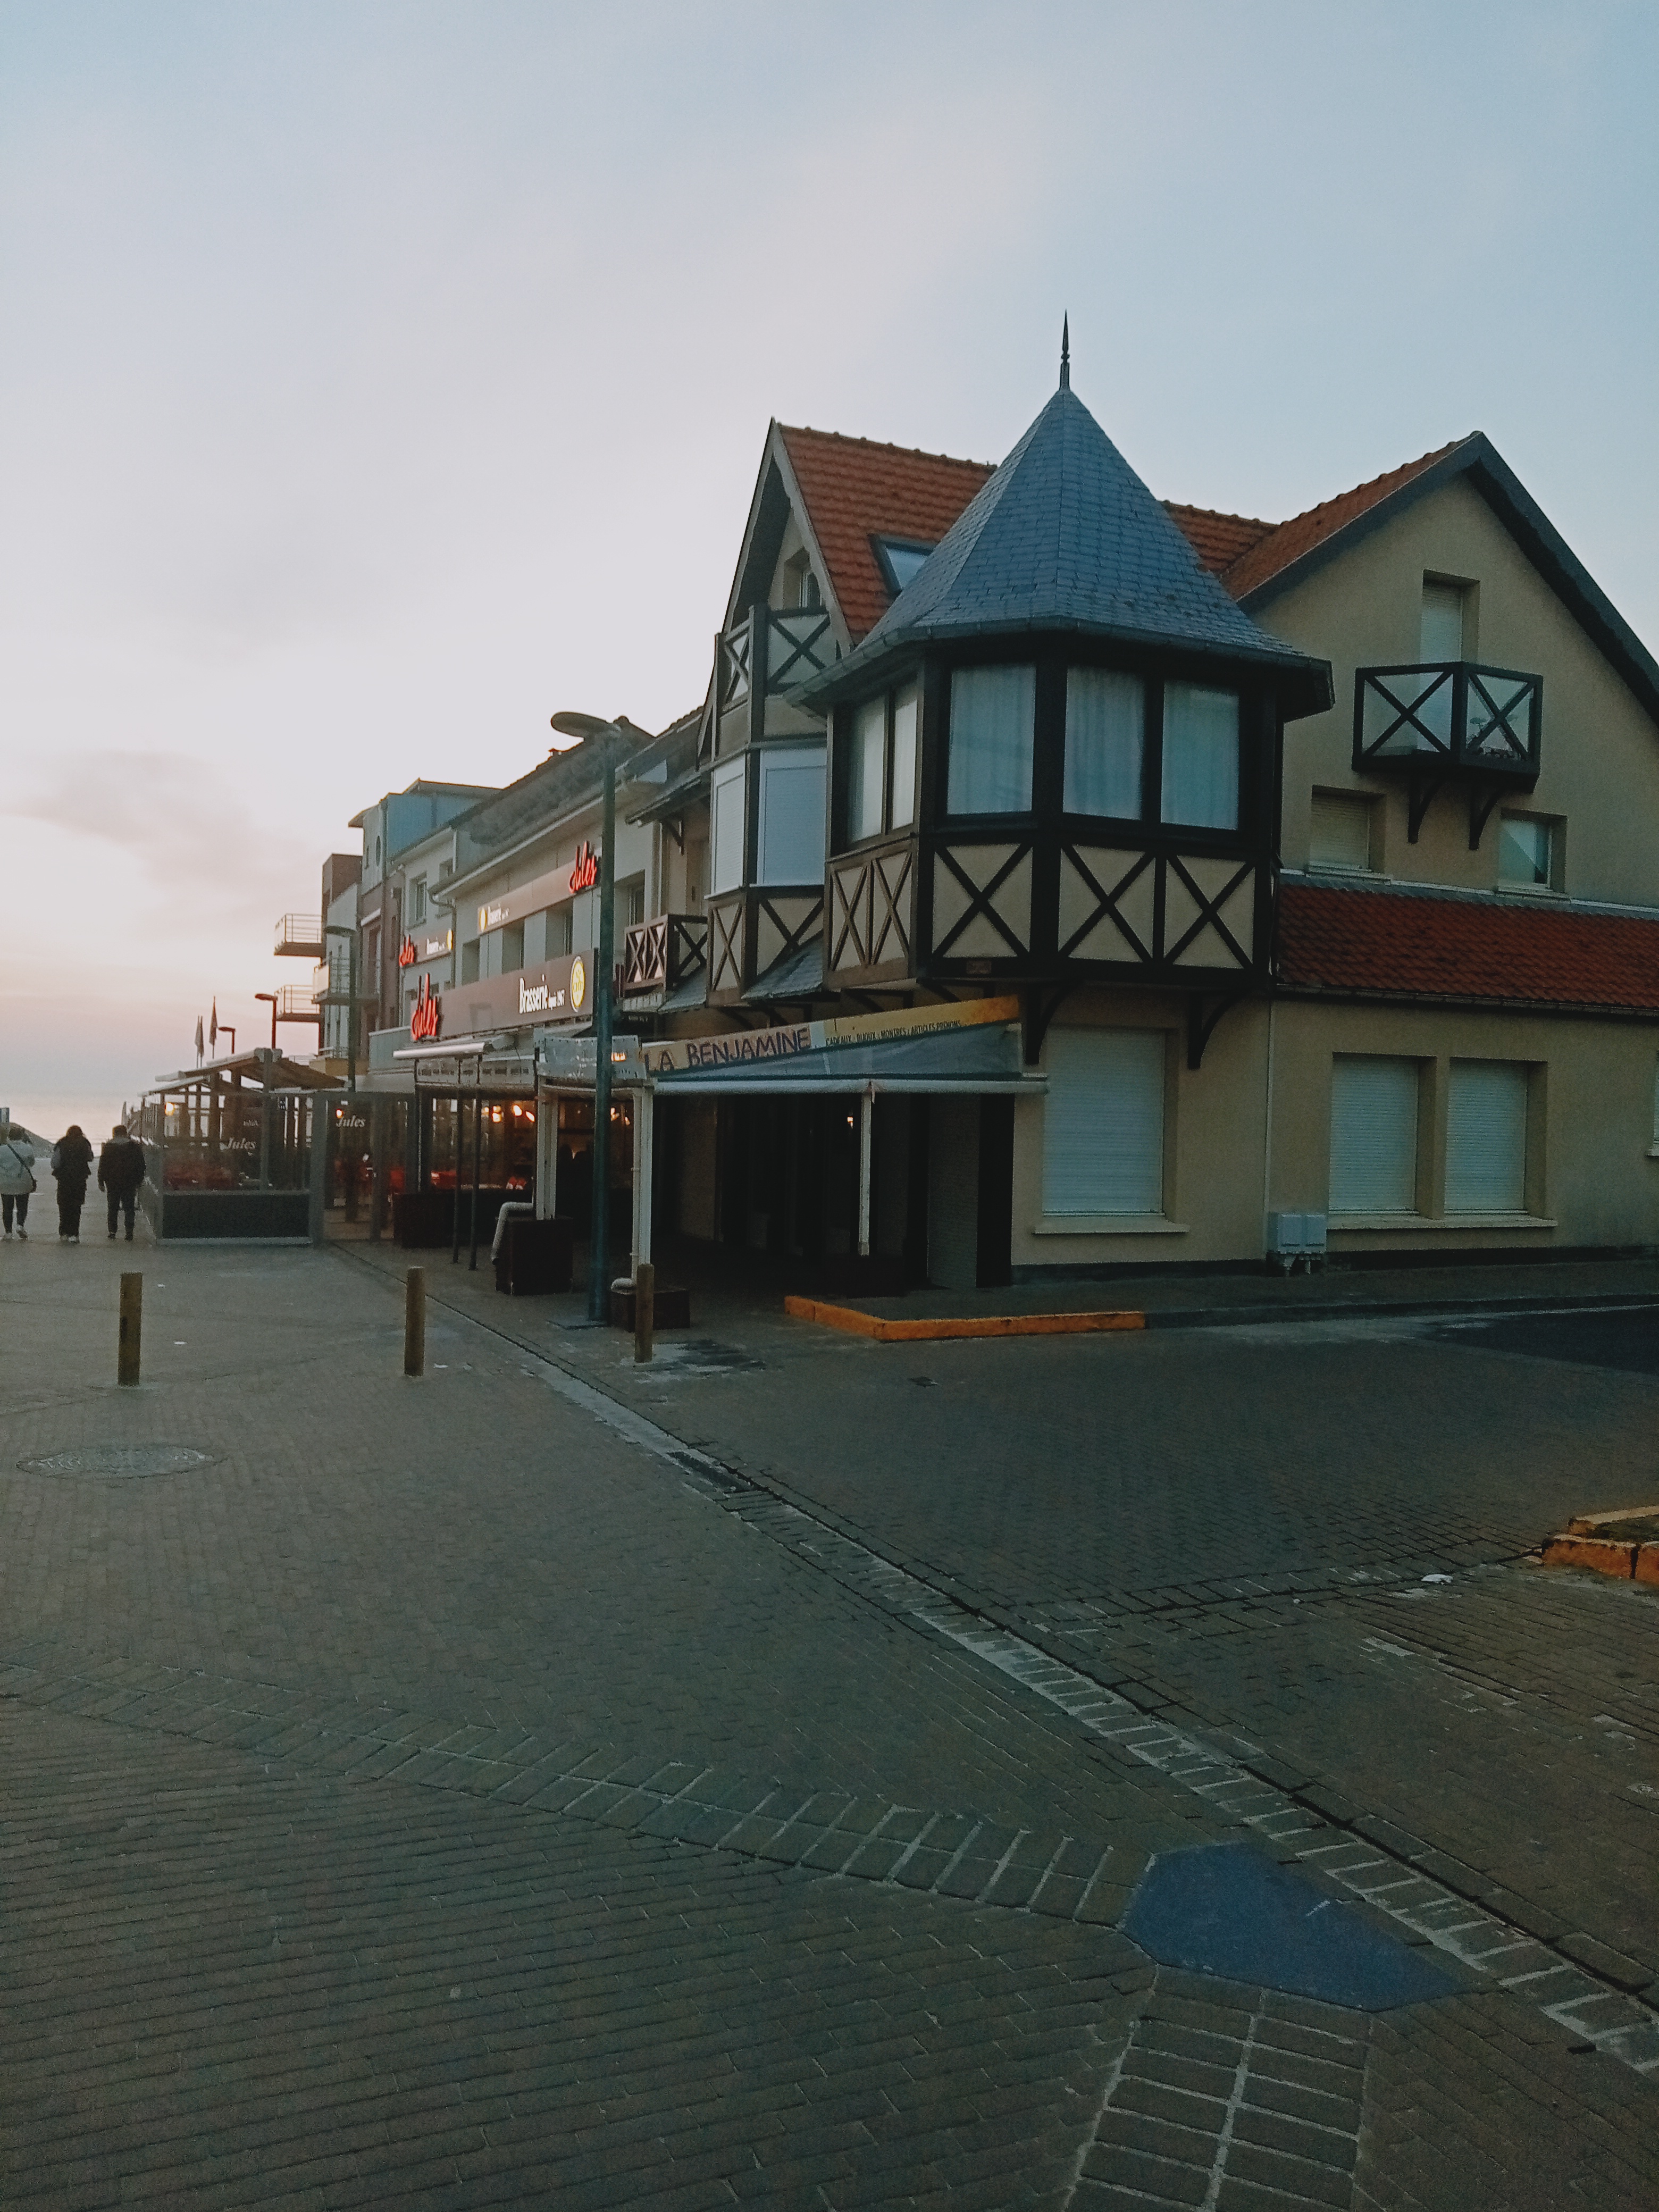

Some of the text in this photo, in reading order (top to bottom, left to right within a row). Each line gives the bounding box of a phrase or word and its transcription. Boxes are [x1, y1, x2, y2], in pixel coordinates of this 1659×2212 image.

[519, 974, 548, 1013] Brasserie
[687, 1027, 810, 1067] BENJAMINE
[826, 1034, 852, 1047] CADEAUX
[336, 1115, 366, 1128] Jules
